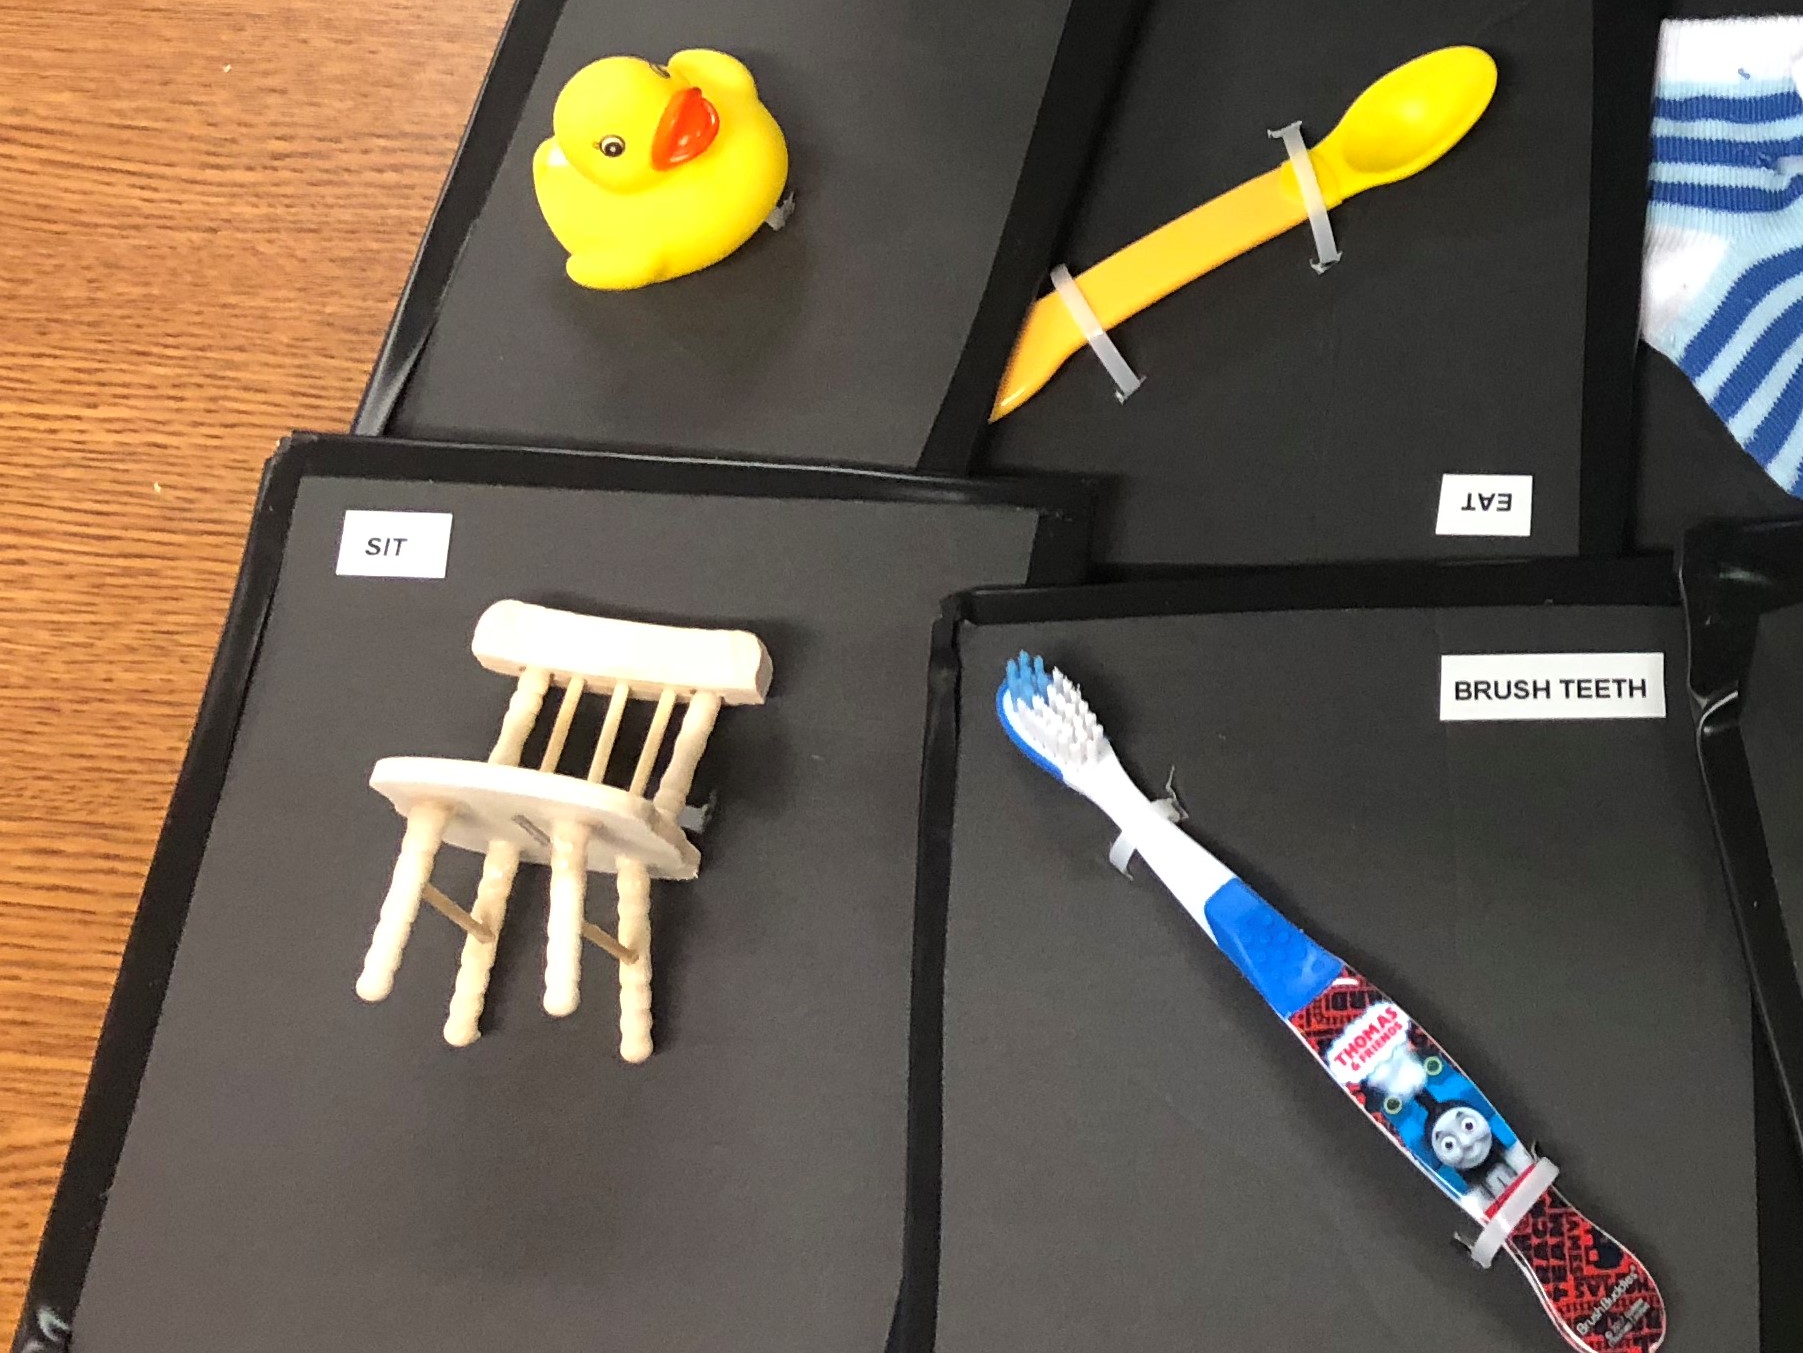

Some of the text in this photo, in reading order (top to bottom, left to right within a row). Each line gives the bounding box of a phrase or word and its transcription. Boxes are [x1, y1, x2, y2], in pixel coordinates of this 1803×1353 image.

[1461, 492, 1512, 512] EAT
[365, 537, 408, 556] SIT
[1454, 678, 1647, 701] BRUSH TEETH
[1334, 1007, 1398, 1066] THOMAS
